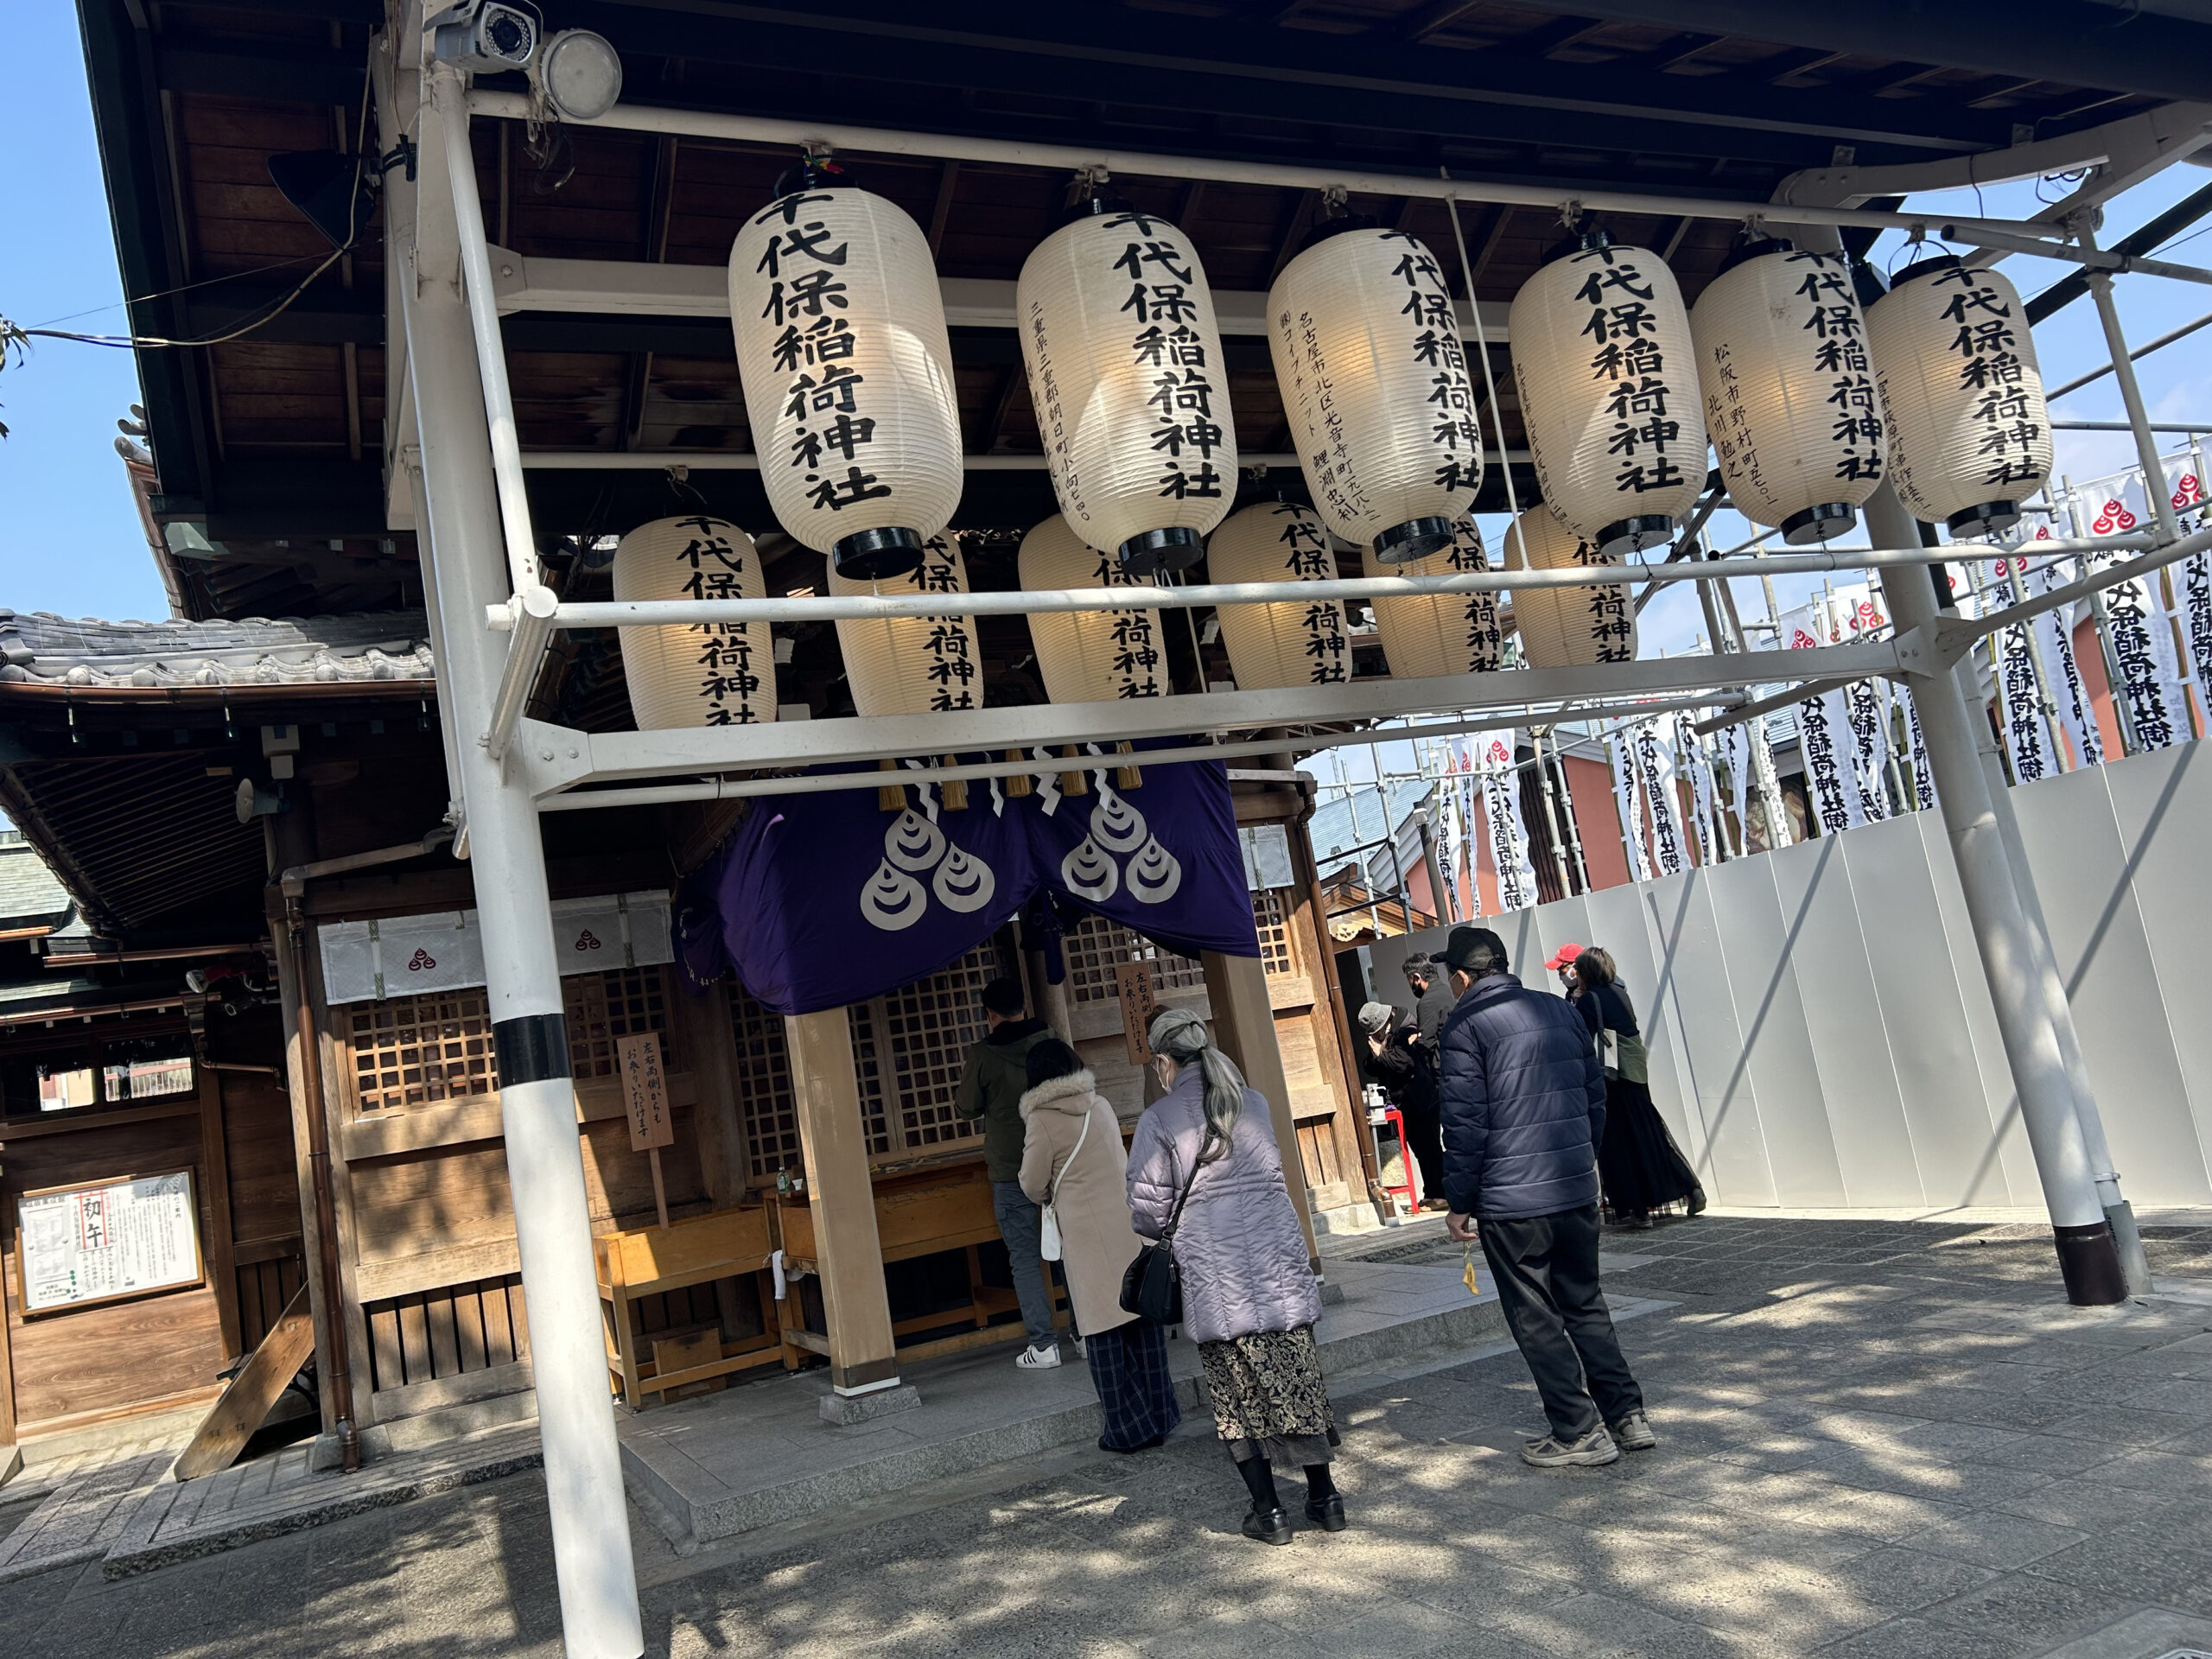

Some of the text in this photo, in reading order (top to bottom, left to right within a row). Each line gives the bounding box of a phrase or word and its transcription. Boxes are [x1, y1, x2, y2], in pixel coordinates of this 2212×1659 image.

[755, 194, 891, 511] 千代保稲荷神社
[1103, 213, 1222, 499] 千代保稲荷神社
[1379, 232, 1480, 492] 千代保稲荷神社
[1571, 245, 1683, 493] 千代保稲荷神社
[1786, 250, 1882, 482] 千代保稲荷神社
[1932, 267, 2041, 486] 千代保稲荷神社
[908, 535, 975, 711] 代保荷神社
[1272, 504, 1345, 684] 千代保荷神社
[1447, 518, 1499, 672] 代保荷神社
[626, 1048, 648, 1138] お参りいただけます
[643, 1042, 661, 1123] 左右両側からも
[83, 1198, 103, 1248] 初午
